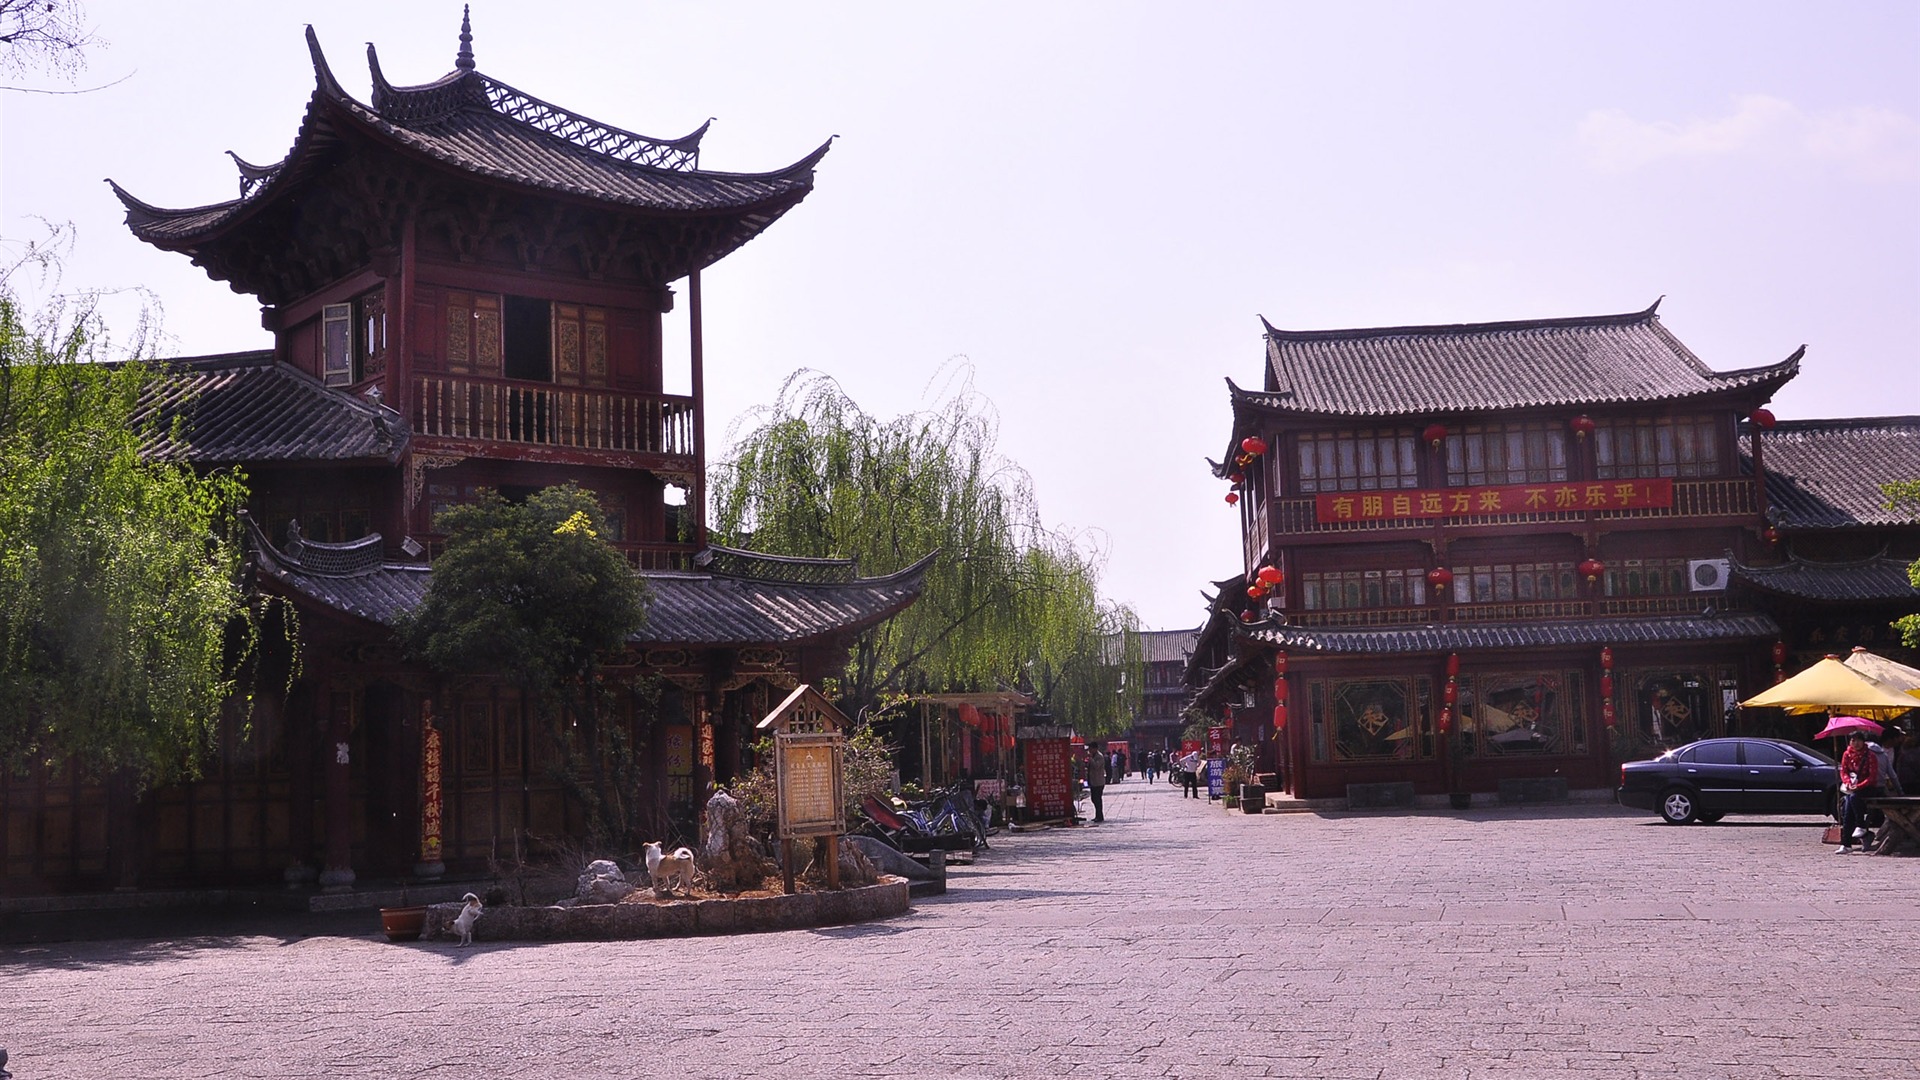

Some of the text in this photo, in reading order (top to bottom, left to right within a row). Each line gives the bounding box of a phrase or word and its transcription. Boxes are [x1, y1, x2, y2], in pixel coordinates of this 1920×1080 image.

[1331, 489, 1502, 519] 有朋自远方来
